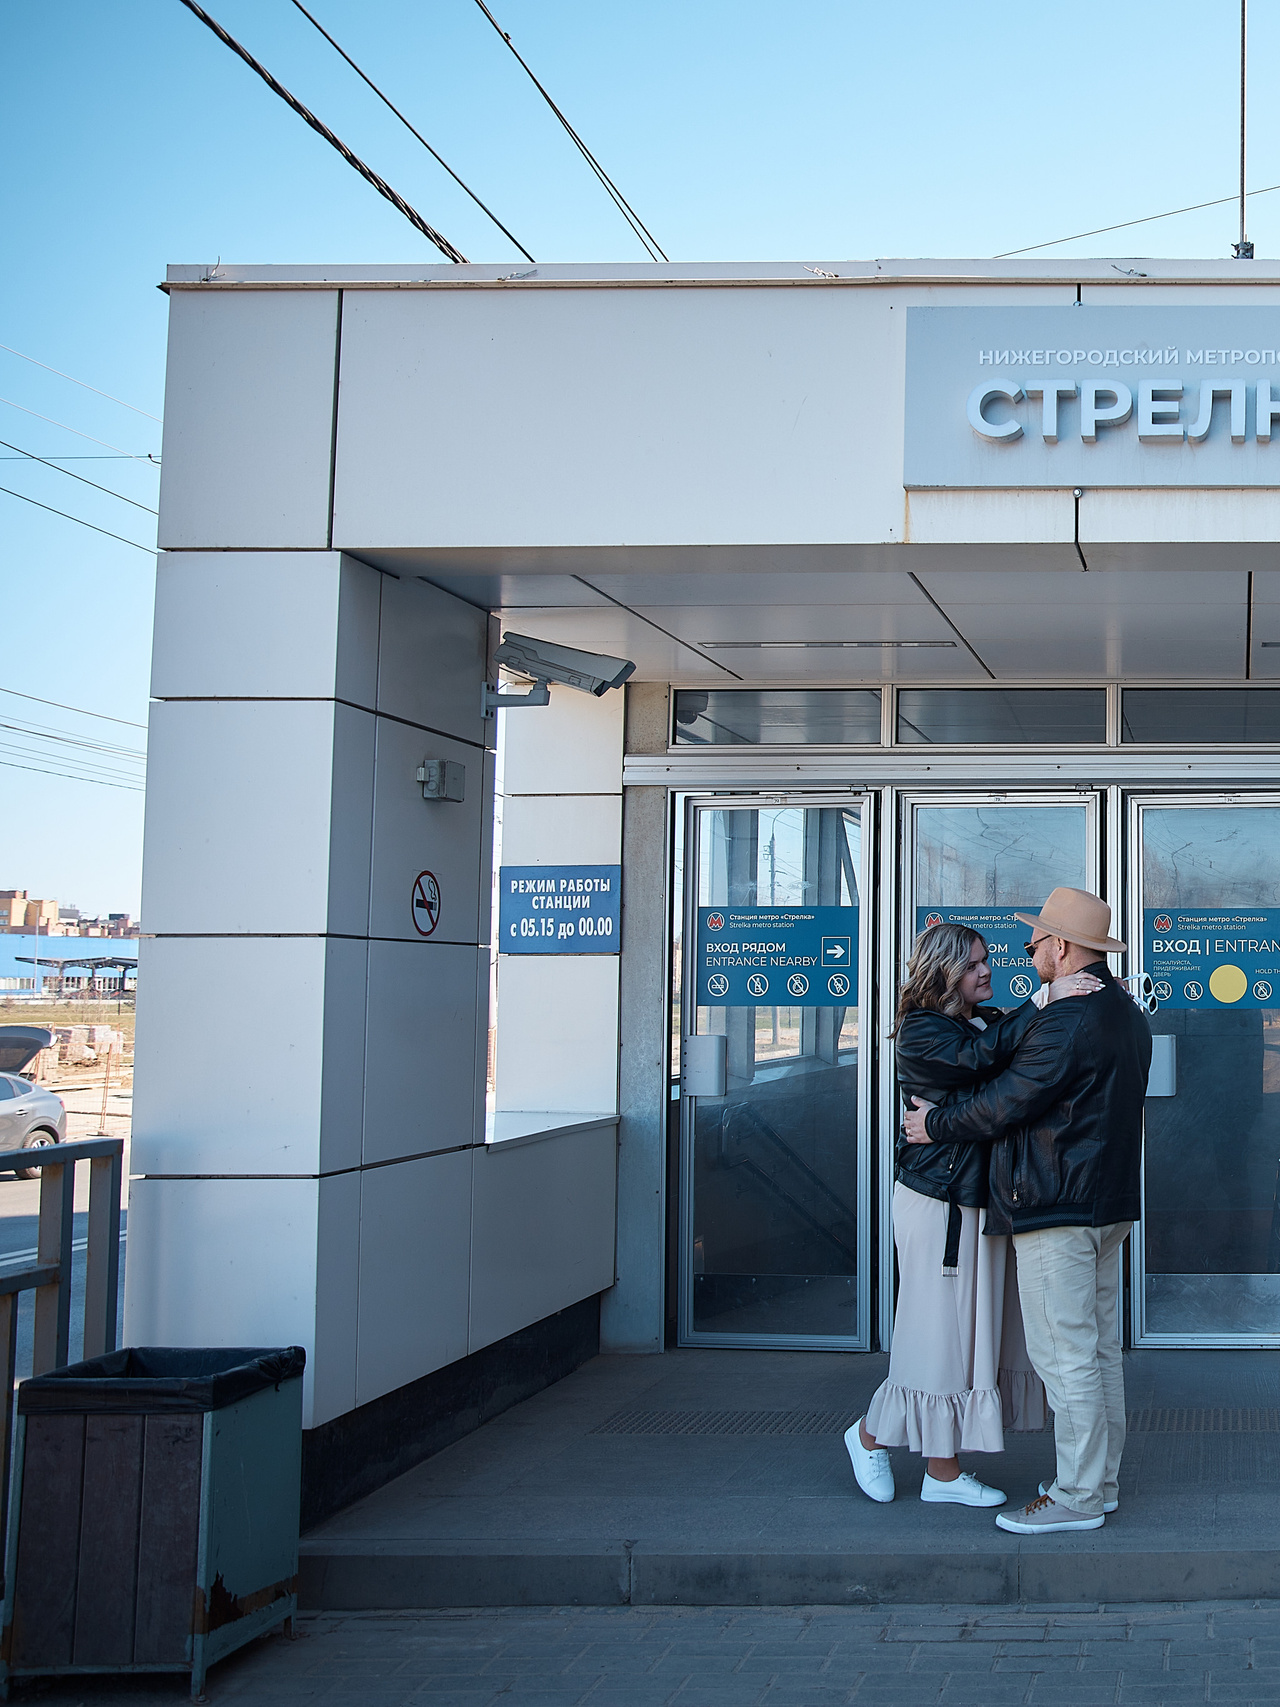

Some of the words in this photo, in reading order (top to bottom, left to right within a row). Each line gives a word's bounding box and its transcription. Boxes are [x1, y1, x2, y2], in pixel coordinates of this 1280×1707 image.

[979, 346, 1179, 366] НИЖЕГОРОДСКИЙ
[511, 880, 555, 894] РЕЖИМ
[560, 878, 610, 893] РАБОТЫ
[532, 896, 590, 911] СТАНЦИИ
[949, 914, 978, 922] Станция
[510, 923, 517, 937] с
[520, 917, 554, 937] 05.15
[558, 921, 574, 939] до
[579, 917, 613, 936] 00.00
[706, 943, 739, 954] ВХОД
[742, 943, 786, 954] РЯДОМ
[1153, 940, 1200, 954] ВХОД
[706, 957, 767, 967] ENTRANCE
[771, 957, 818, 966] NEARBY
[992, 958, 1034, 967] NEARB
